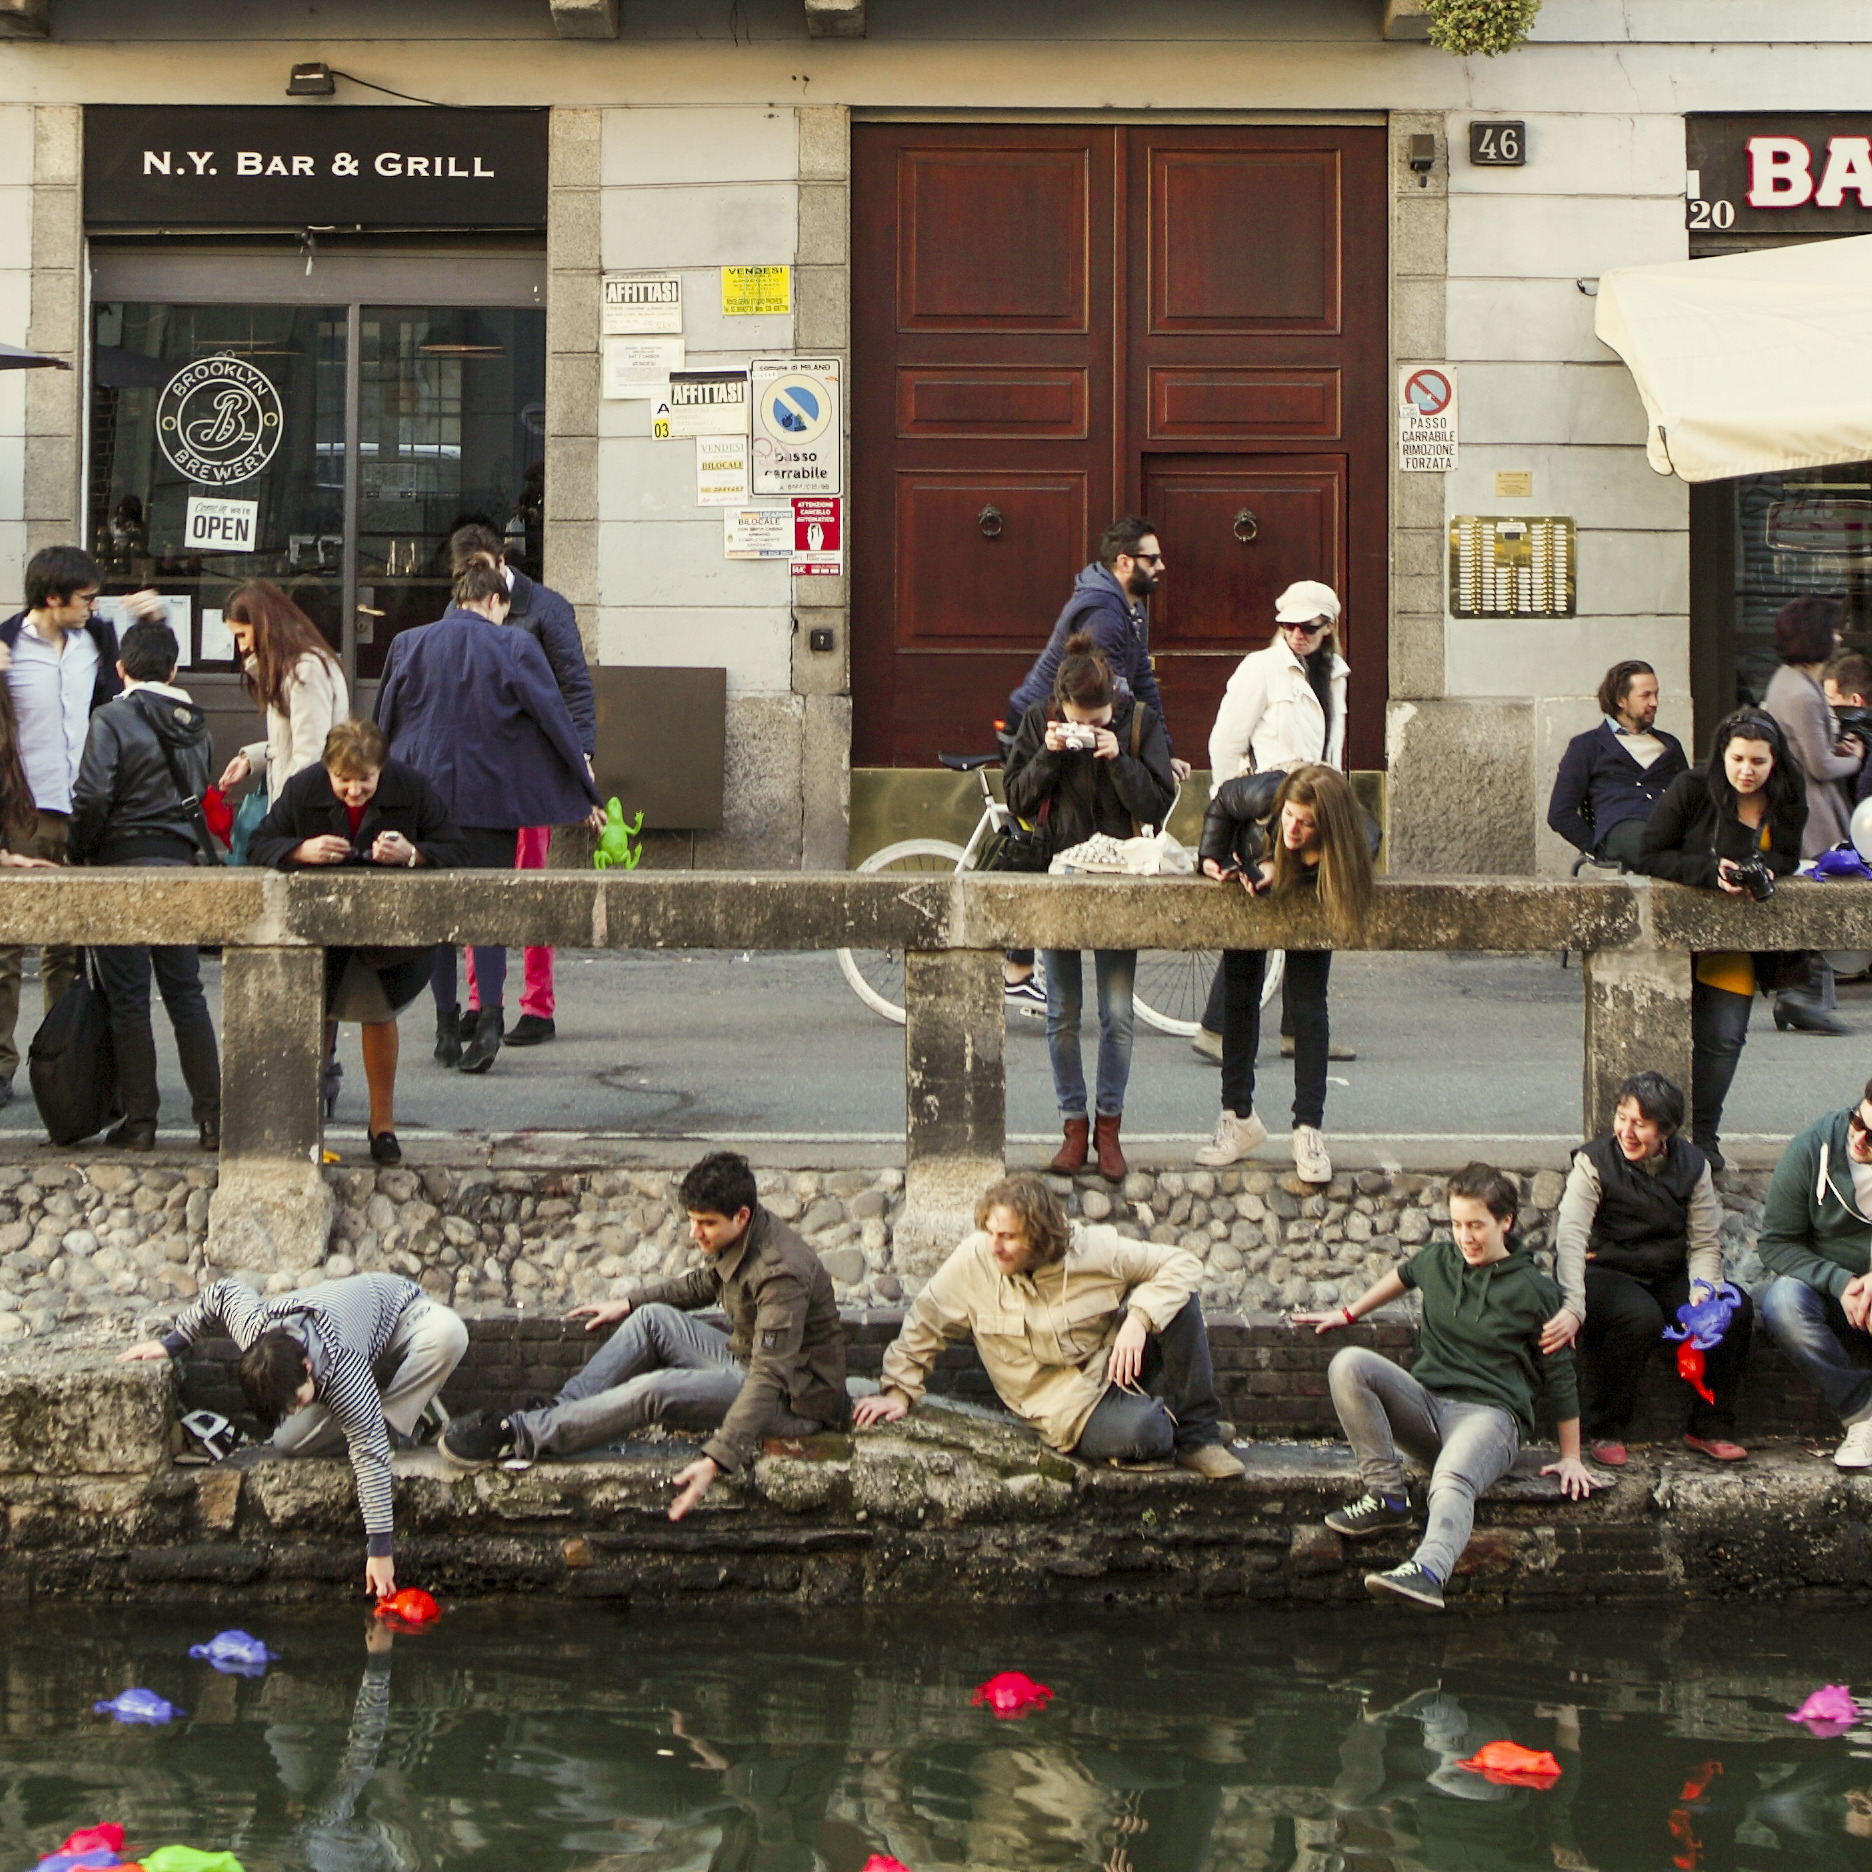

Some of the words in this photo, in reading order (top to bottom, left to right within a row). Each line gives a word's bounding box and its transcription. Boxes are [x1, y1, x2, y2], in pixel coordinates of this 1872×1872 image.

[1479, 129, 1519, 160] 46
[142, 151, 217, 176] N.Y.
[331, 151, 359, 177] &
[1689, 201, 1735, 230] 20
[607, 282, 677, 303] AFFITTASI
[172, 361, 269, 398] BROOKLYN
[672, 383, 744, 405] AFFITTASI
[654, 423, 669, 438] 03
[1410, 417, 1447, 429] PASSO
[1402, 431, 1455, 442] CARRABILE
[701, 443, 745, 453] VENDESI
[1403, 444, 1455, 455] RIMOZIONE
[173, 442, 268, 482] BREWERY
[701, 461, 744, 470] BILOCALE
[1406, 457, 1452, 469] FORZATA
[192, 515, 250, 542] OPEN
